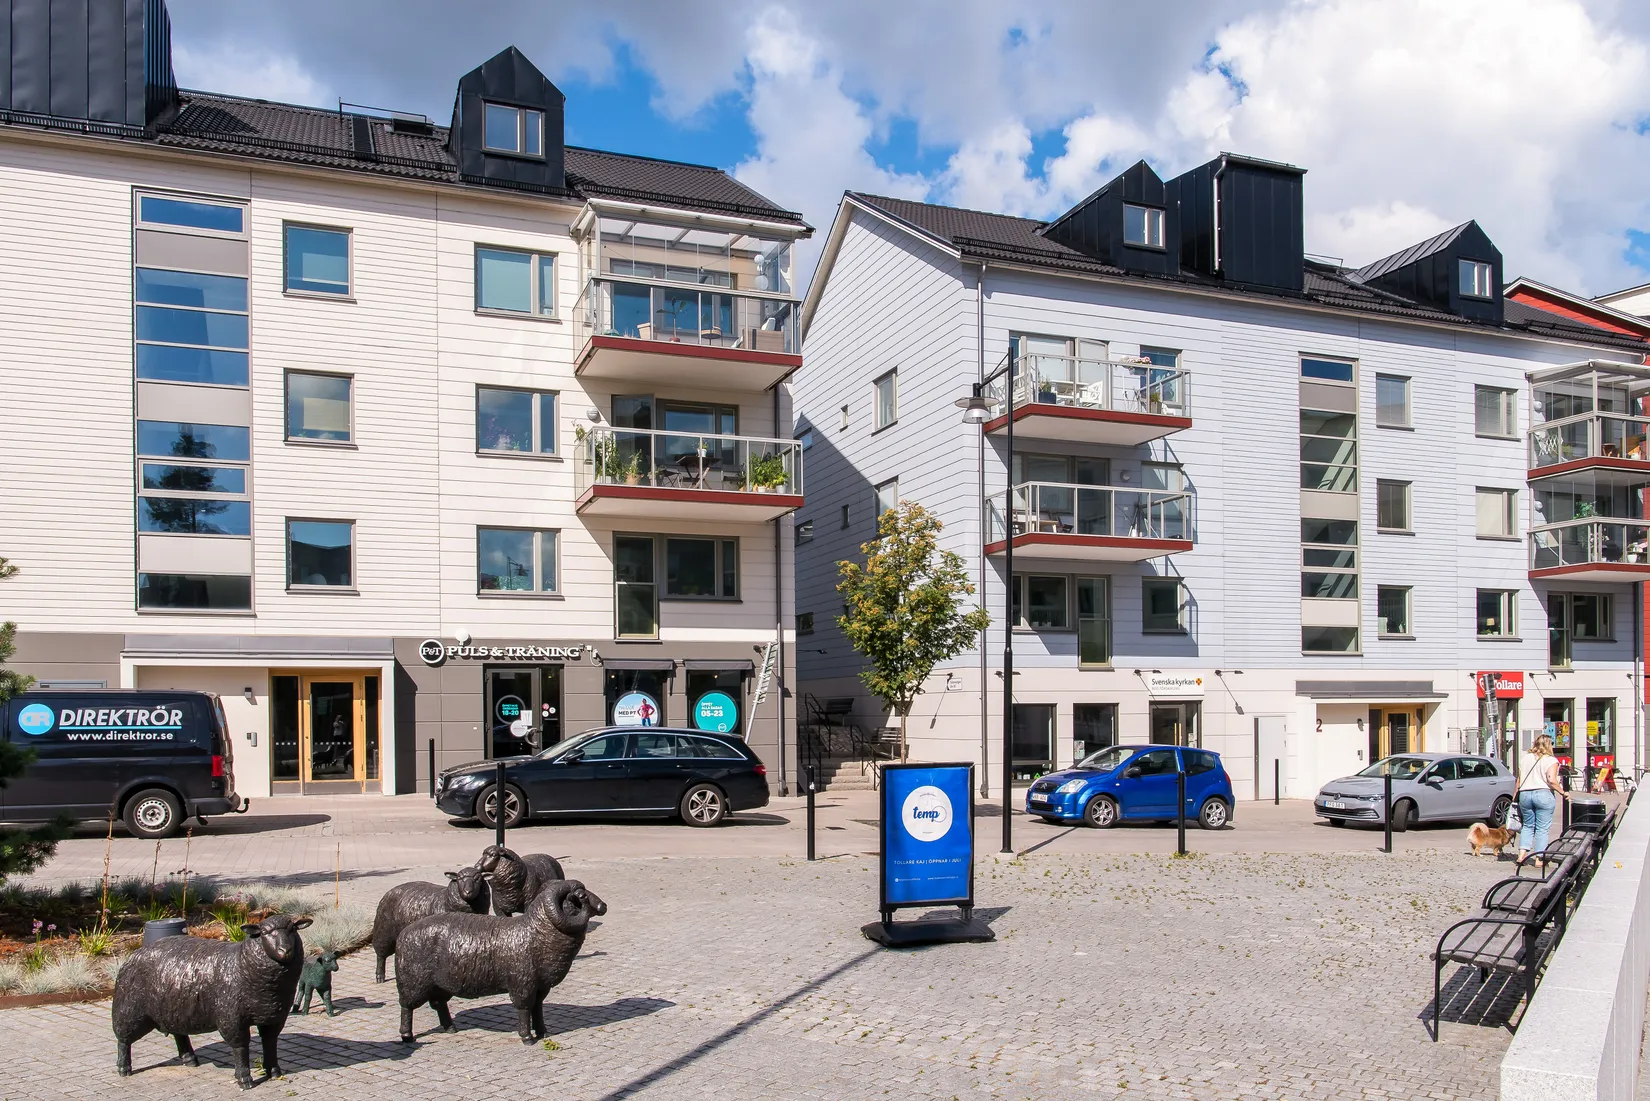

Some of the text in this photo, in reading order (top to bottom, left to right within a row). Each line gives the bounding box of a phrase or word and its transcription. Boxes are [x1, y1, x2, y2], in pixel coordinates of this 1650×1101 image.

[422, 647, 441, 656] P&T
[446, 644, 580, 657] PULS & TRÄNING
[59, 705, 183, 726] DIREKTRÖR
[1316, 718, 1323, 732] 2
[67, 730, 174, 741] www.direktror.se
